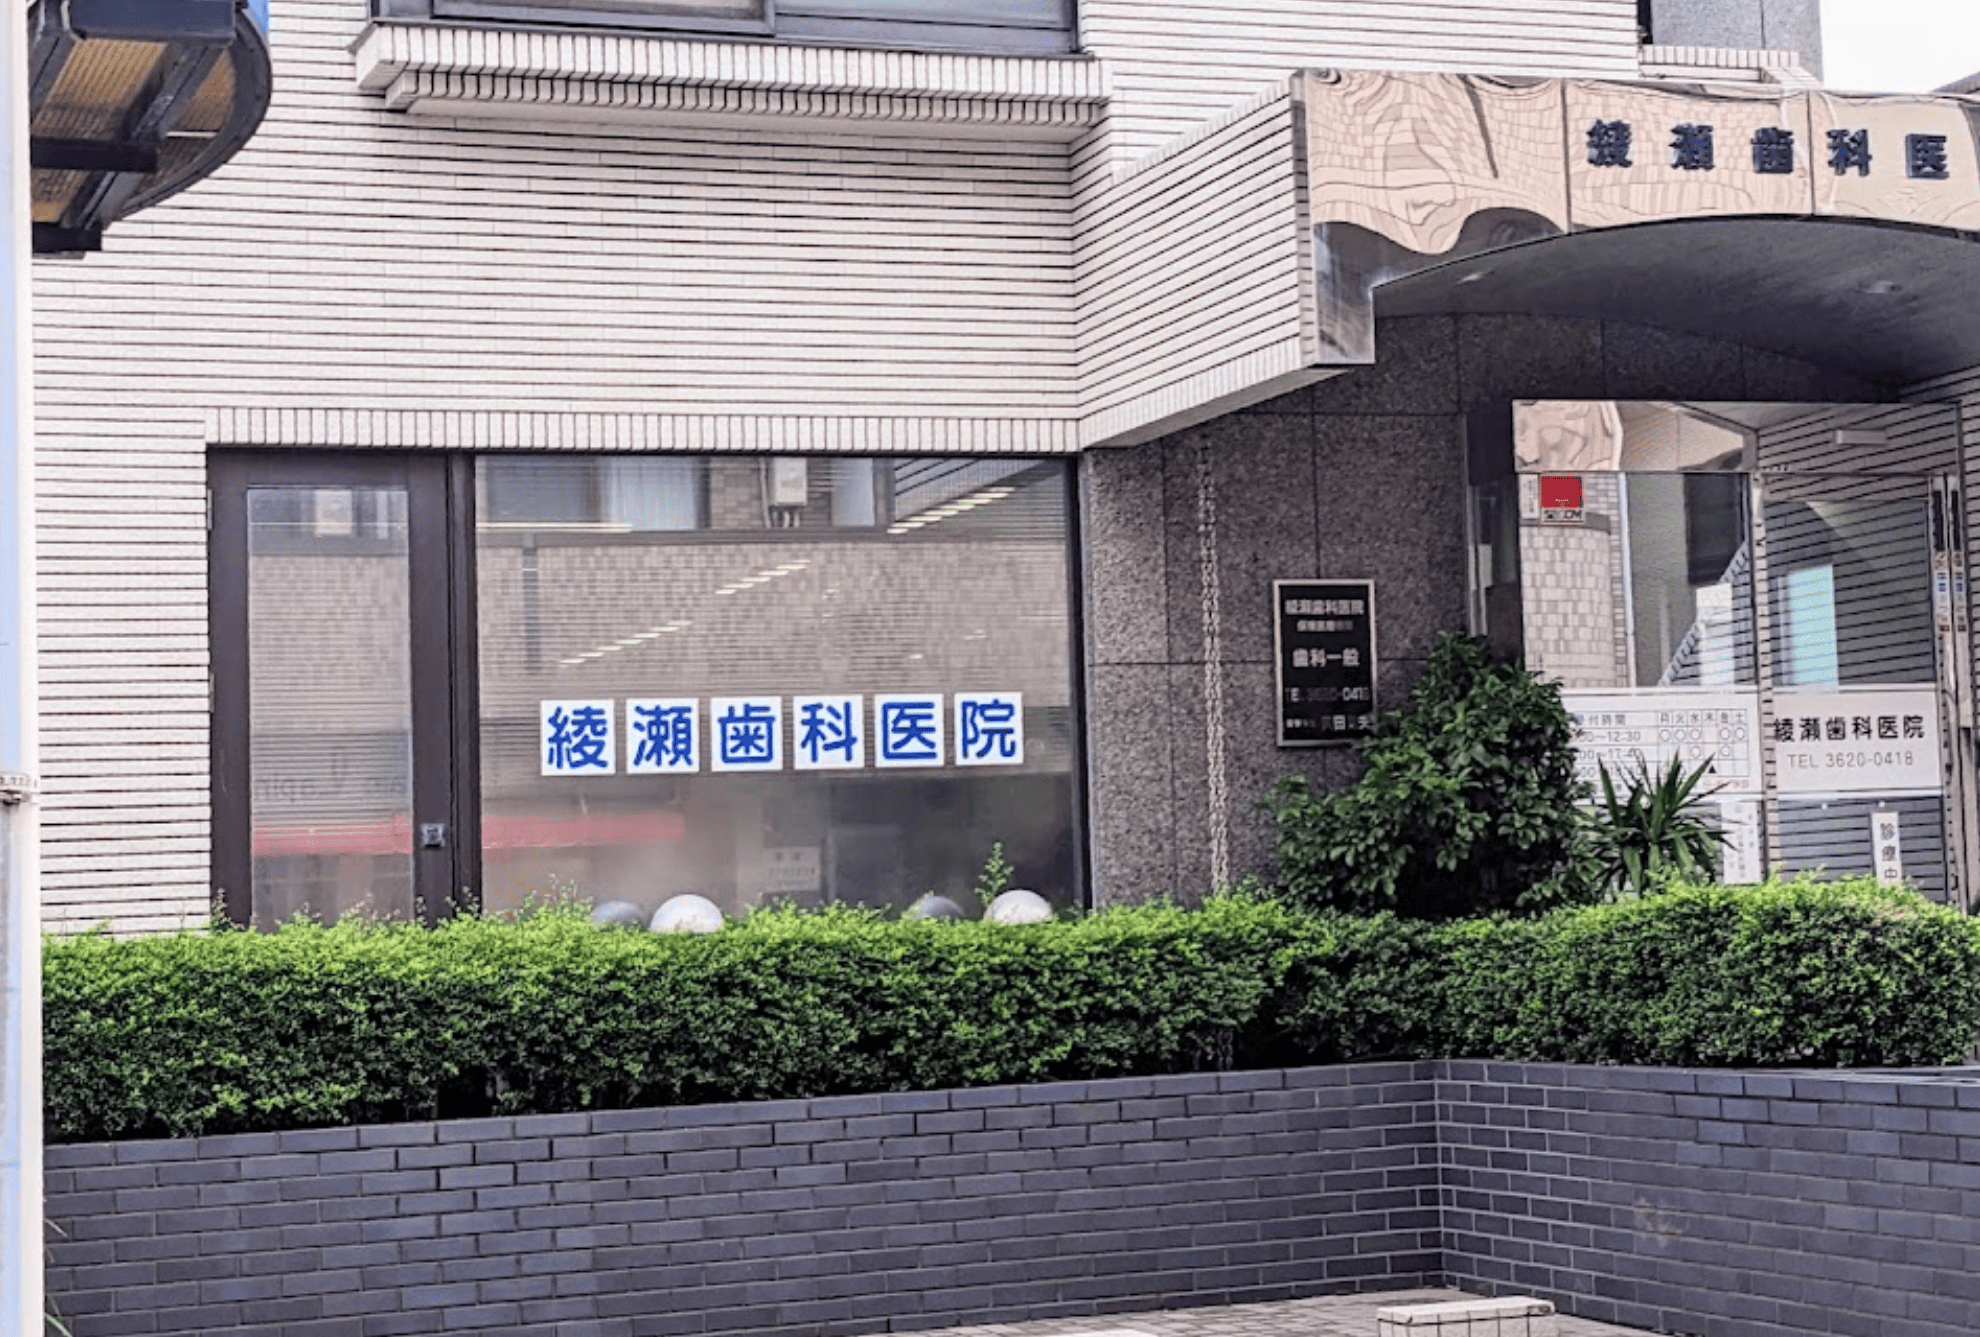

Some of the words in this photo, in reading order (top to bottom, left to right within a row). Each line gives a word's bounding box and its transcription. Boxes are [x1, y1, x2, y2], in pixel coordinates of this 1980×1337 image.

[546, 698, 1018, 770] 綾瀬歯科医院
[1773, 714, 1926, 743] 綾瀬歯科医院
[1787, 753, 1819, 769] TEL
[1825, 750, 1915, 768] 3620-0418
